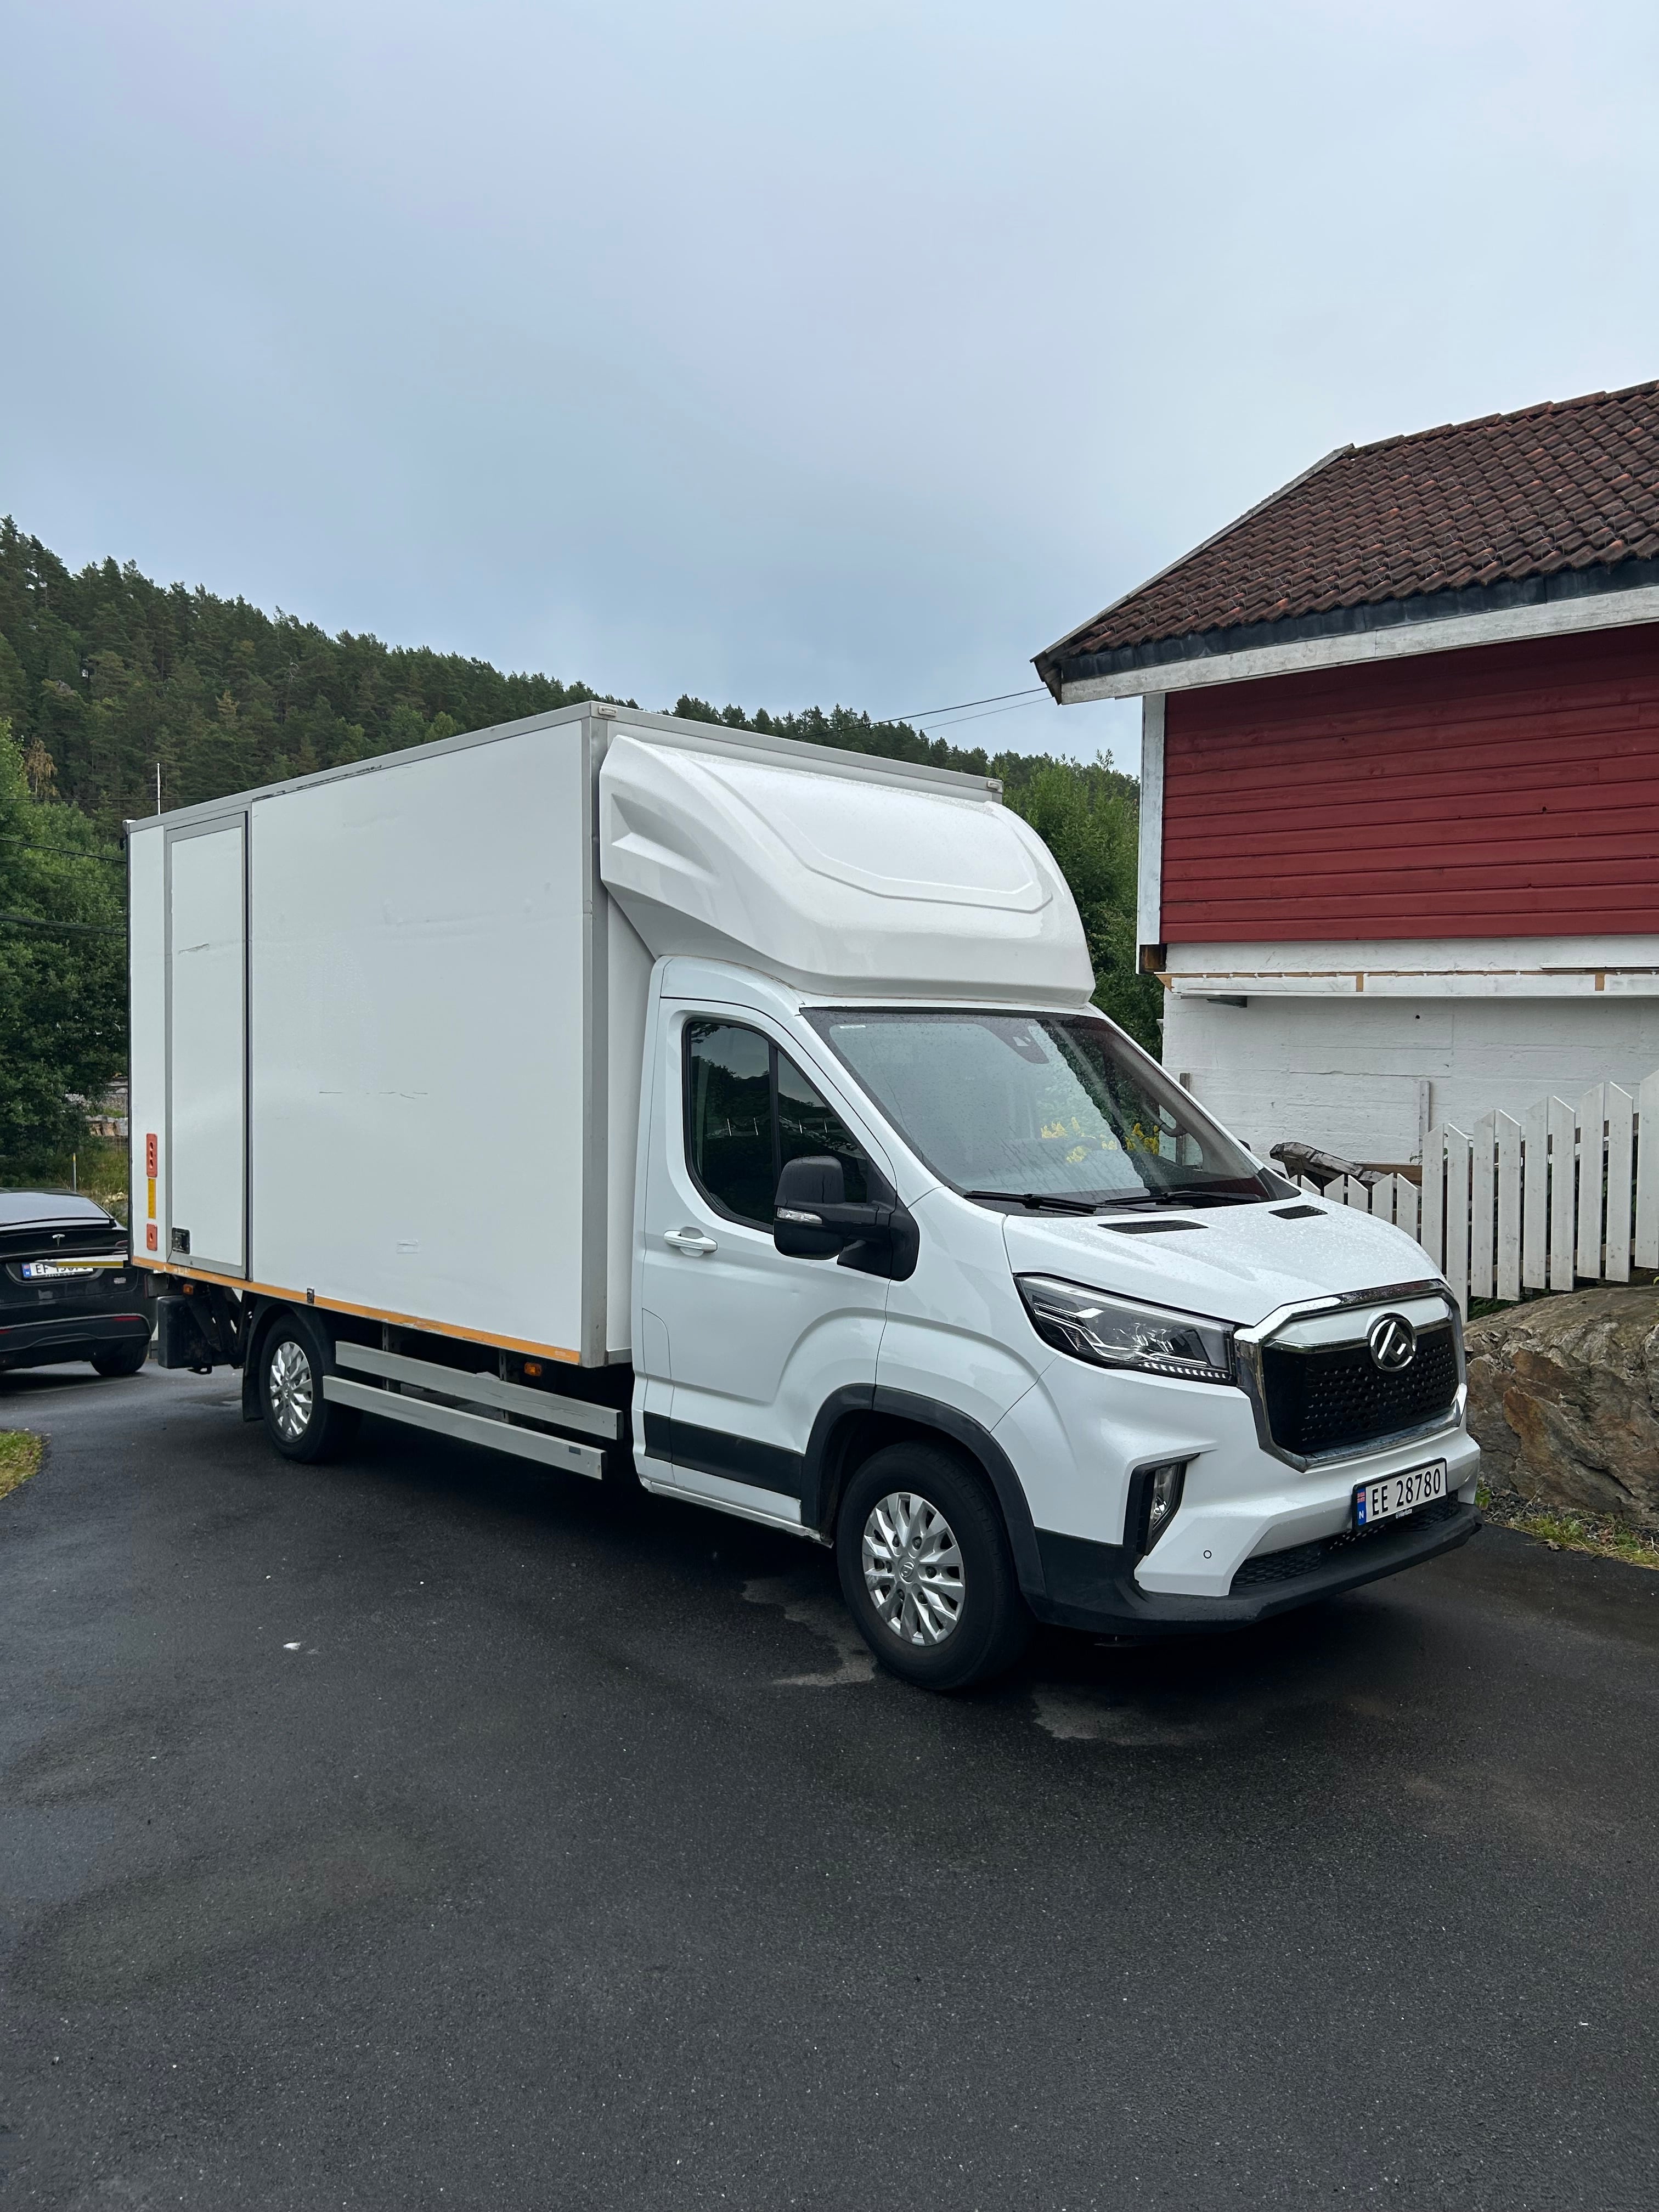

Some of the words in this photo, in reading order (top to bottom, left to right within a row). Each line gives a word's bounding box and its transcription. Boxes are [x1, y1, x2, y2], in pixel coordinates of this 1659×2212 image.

[1359, 1510, 1364, 1519] N
[1372, 1485, 1389, 1516] EE
[1396, 1468, 1441, 1508] 28780
